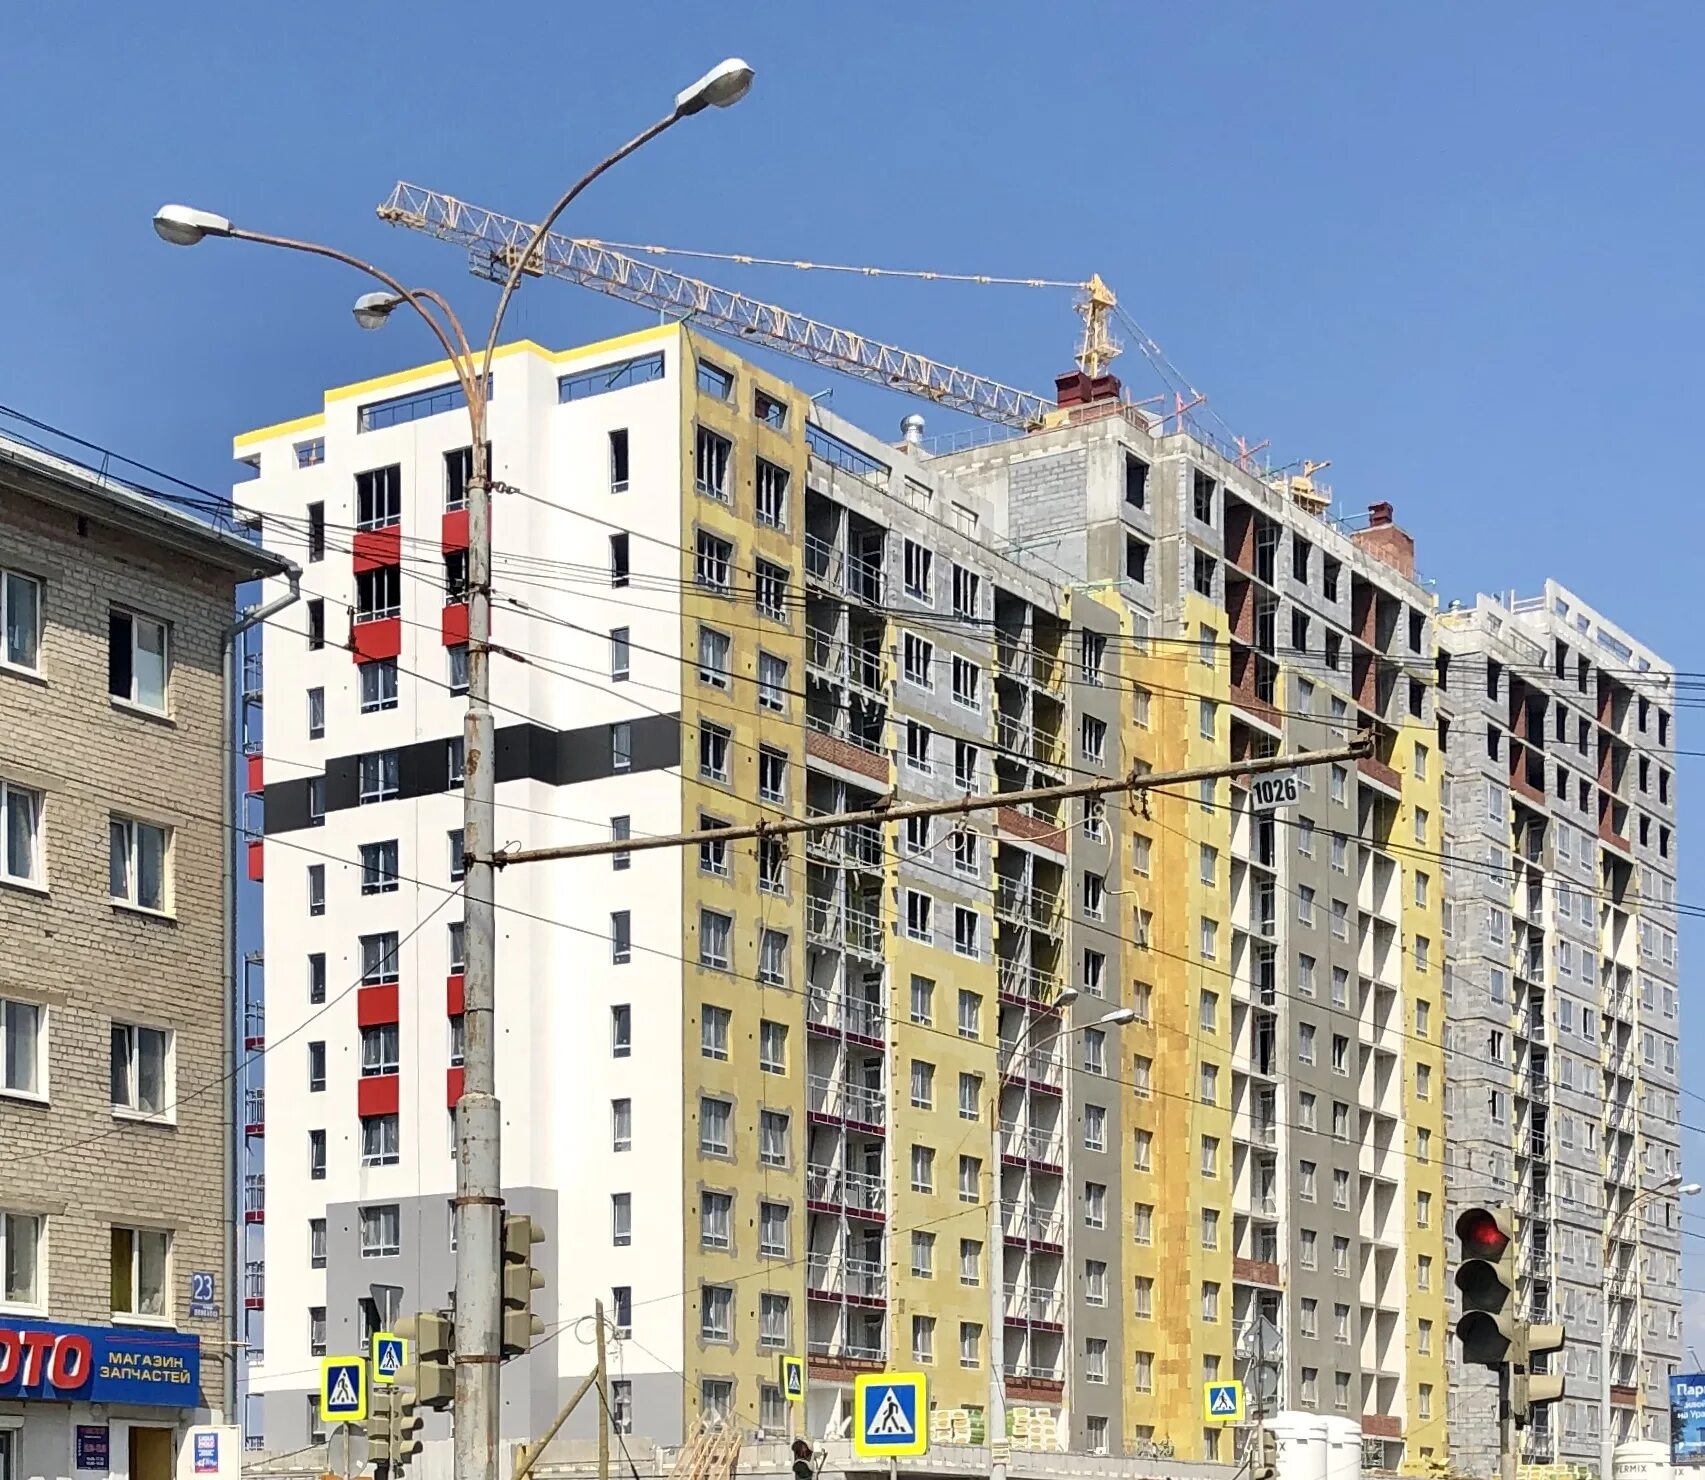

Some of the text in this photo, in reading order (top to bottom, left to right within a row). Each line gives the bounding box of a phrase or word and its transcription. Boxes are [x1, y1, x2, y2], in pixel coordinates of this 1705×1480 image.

[1253, 778, 1297, 805] 1026
[193, 1274, 213, 1301] 23
[108, 1351, 184, 1369] МАГАЗИН
[99, 1366, 191, 1385] ЗАПЧАСТЕЙ
[1676, 1383, 1705, 1398] Пар
